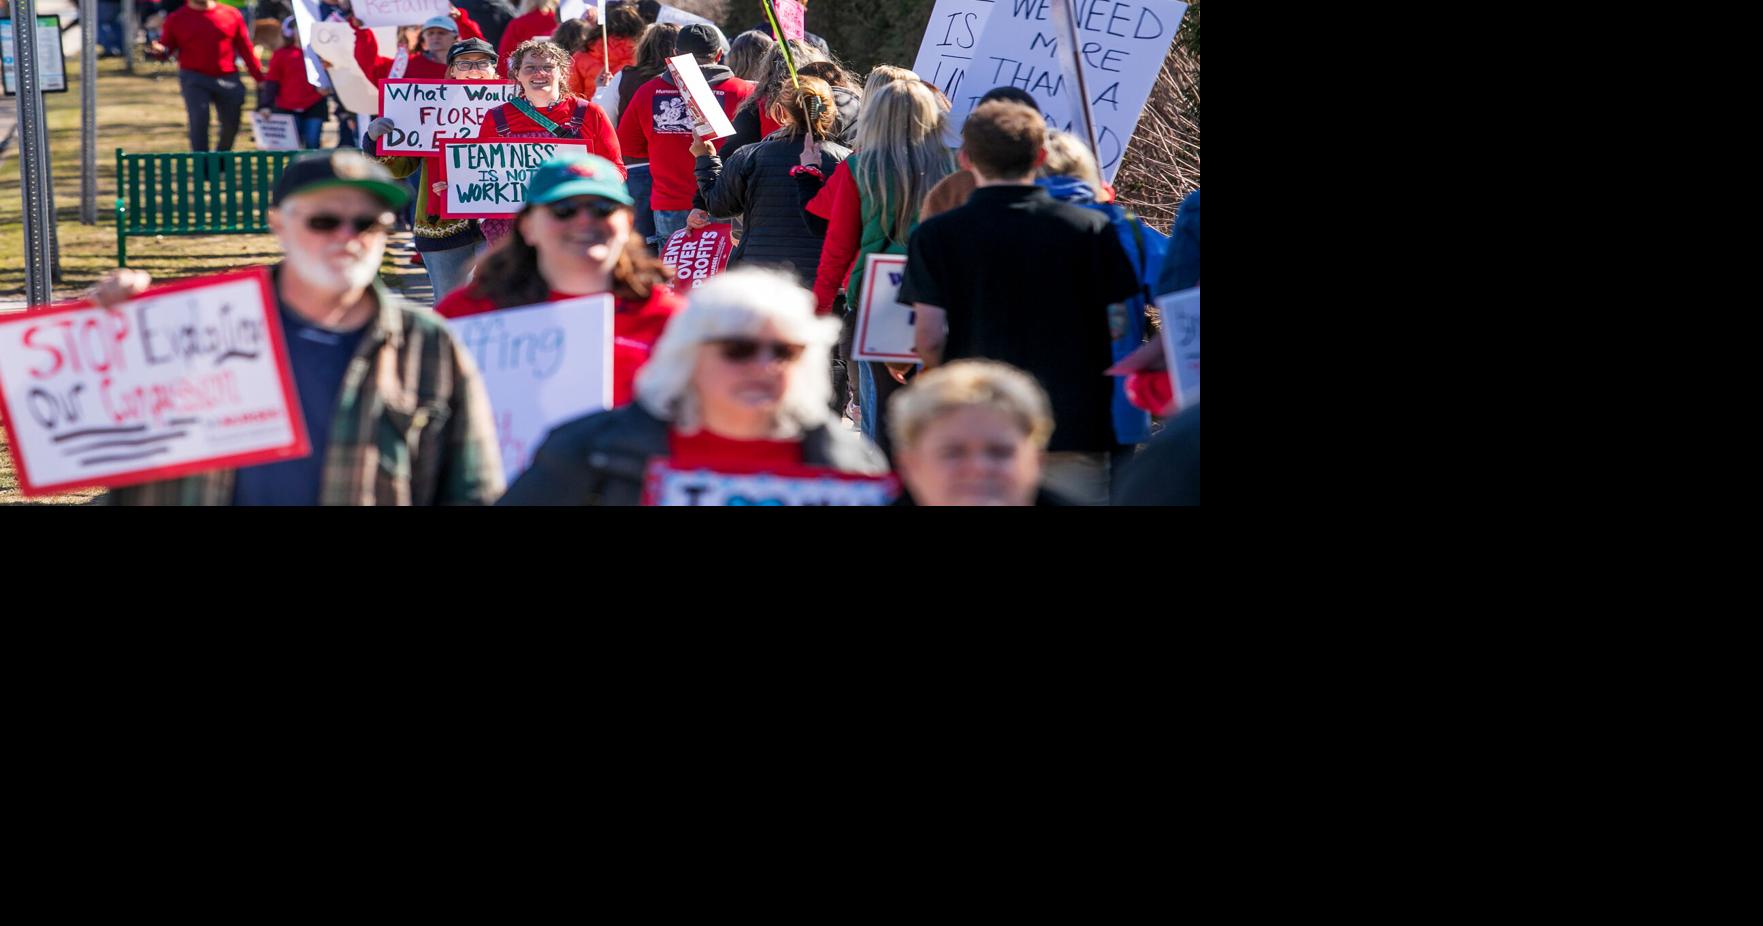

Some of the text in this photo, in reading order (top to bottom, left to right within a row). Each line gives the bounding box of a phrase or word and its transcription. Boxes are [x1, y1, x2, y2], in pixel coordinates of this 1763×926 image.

[936, 12, 977, 49] IS
[1013, 0, 1163, 39] WE NEED
[1030, 32, 1130, 73] MRE
[387, 83, 447, 101] What
[1092, 82, 1120, 111] A
[419, 106, 485, 125] FLORE
[456, 181, 529, 205] WORKIN
[478, 169, 540, 182] IS NOT
[677, 240, 699, 279] OVER
[691, 231, 718, 289] PROFITS
[23, 309, 129, 379] STOP
